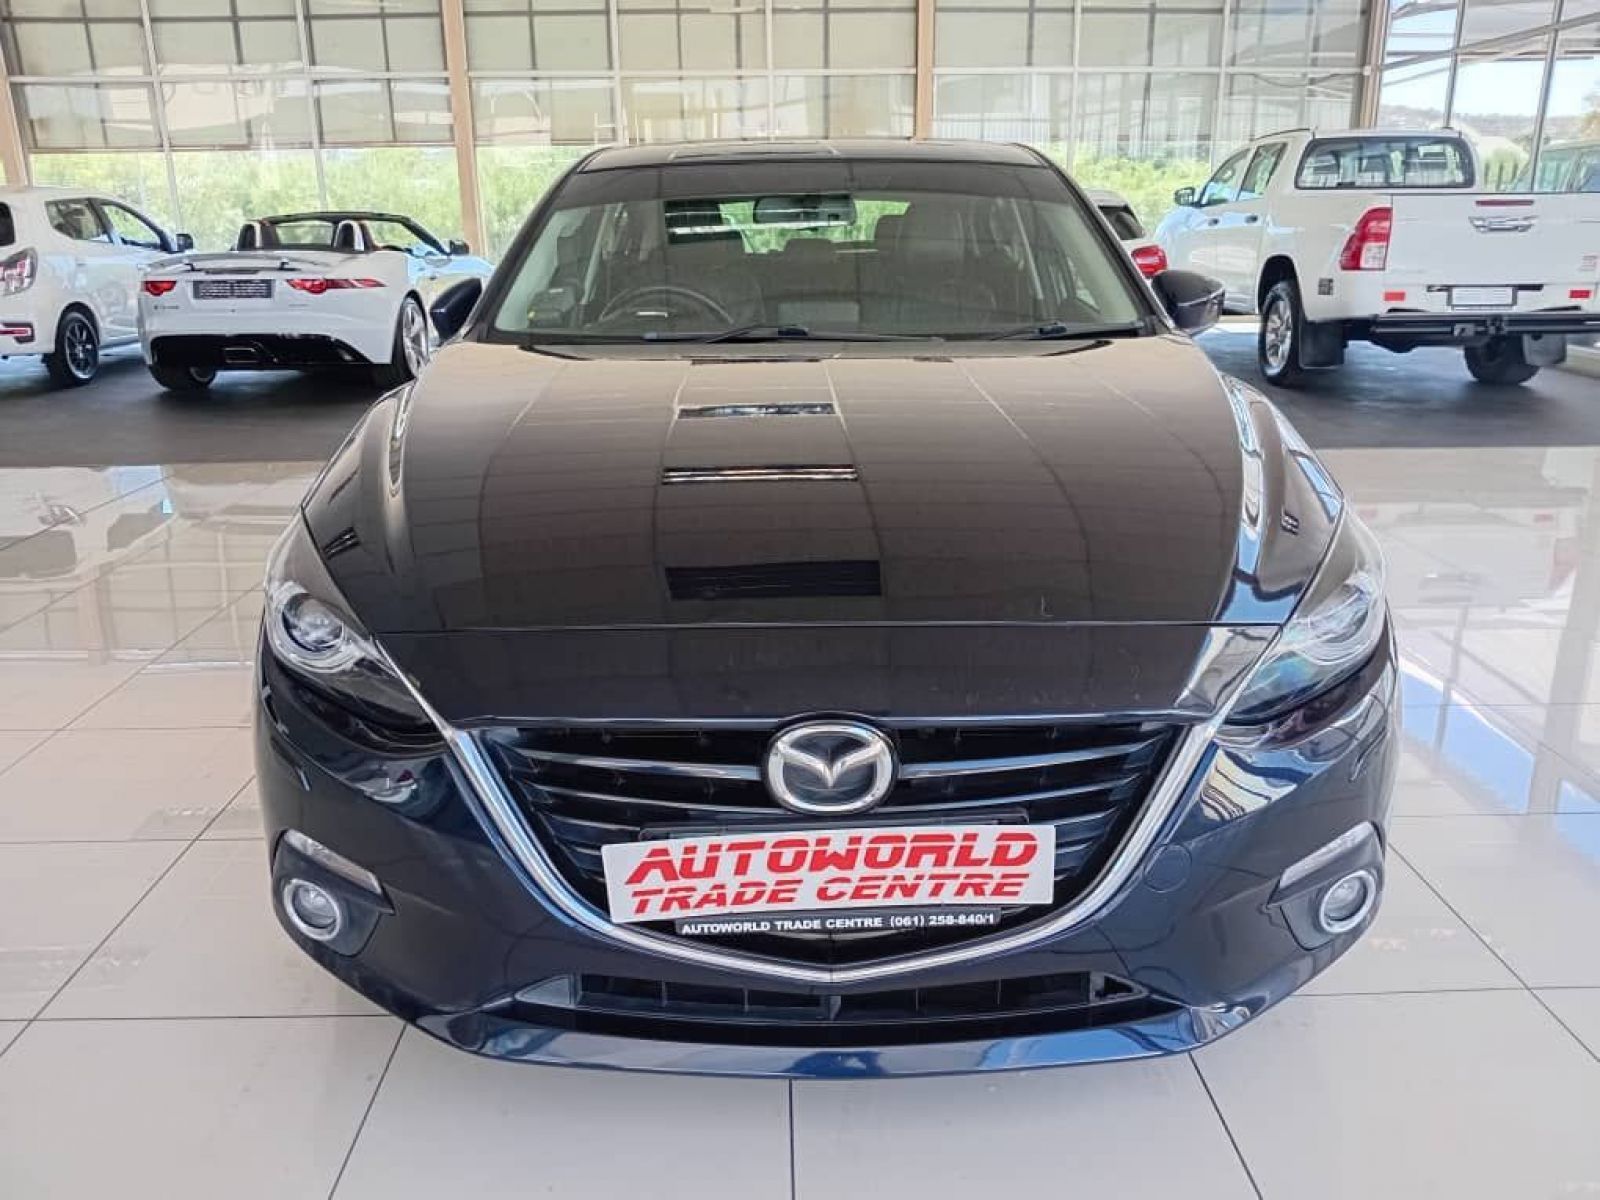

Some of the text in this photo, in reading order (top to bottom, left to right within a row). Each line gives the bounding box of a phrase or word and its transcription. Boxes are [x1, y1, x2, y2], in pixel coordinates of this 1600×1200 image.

[627, 832, 1039, 885] AUTOWORLD
[632, 871, 1029, 914] TRADE CENTRE
[681, 921, 771, 935] AUTOWORLD
[775, 918, 822, 930] TRADE
[826, 917, 883, 928] CENTRE
[890, 915, 924, 927] (061)
